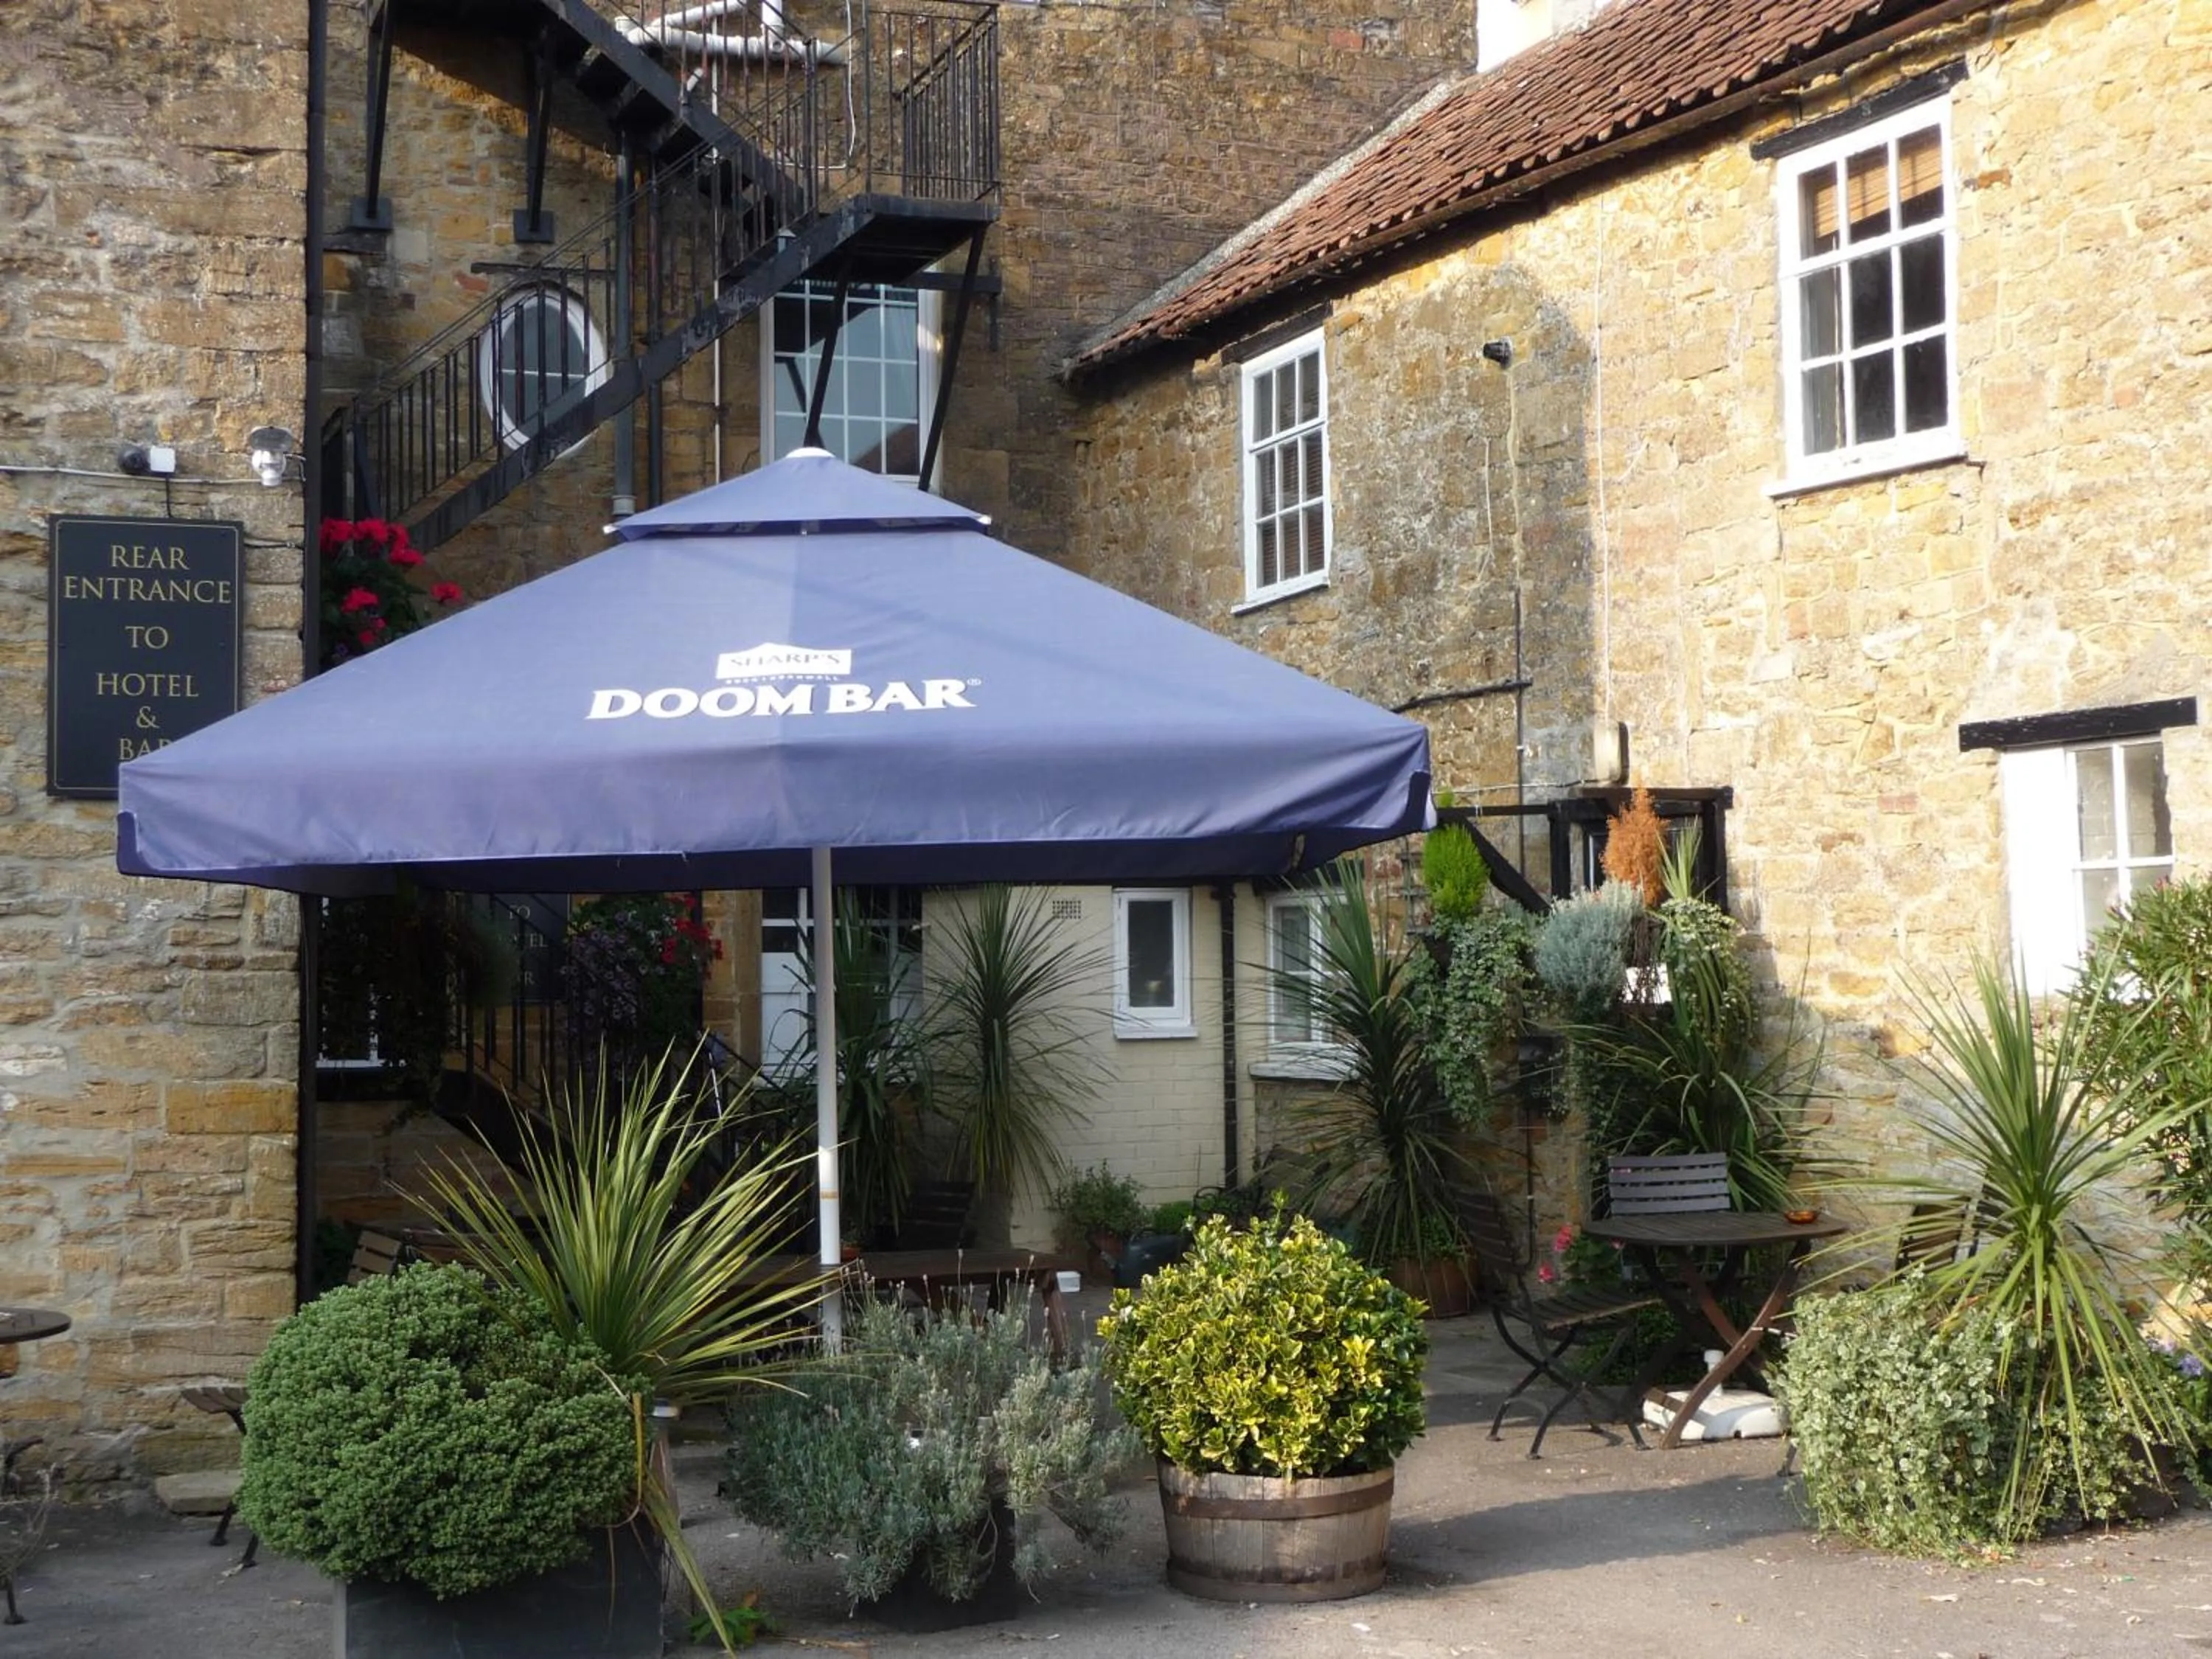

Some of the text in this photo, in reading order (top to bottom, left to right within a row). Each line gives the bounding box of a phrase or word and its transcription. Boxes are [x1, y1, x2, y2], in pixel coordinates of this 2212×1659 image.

[111, 545, 189, 570] REAR
[64, 576, 232, 604] ENTRANCE
[125, 625, 169, 650] TO
[730, 653, 841, 667] SHARP'S
[97, 672, 199, 697] HOTEL
[585, 684, 815, 720] DOOM
[136, 706, 160, 728] &
[119, 737, 173, 760] BA
